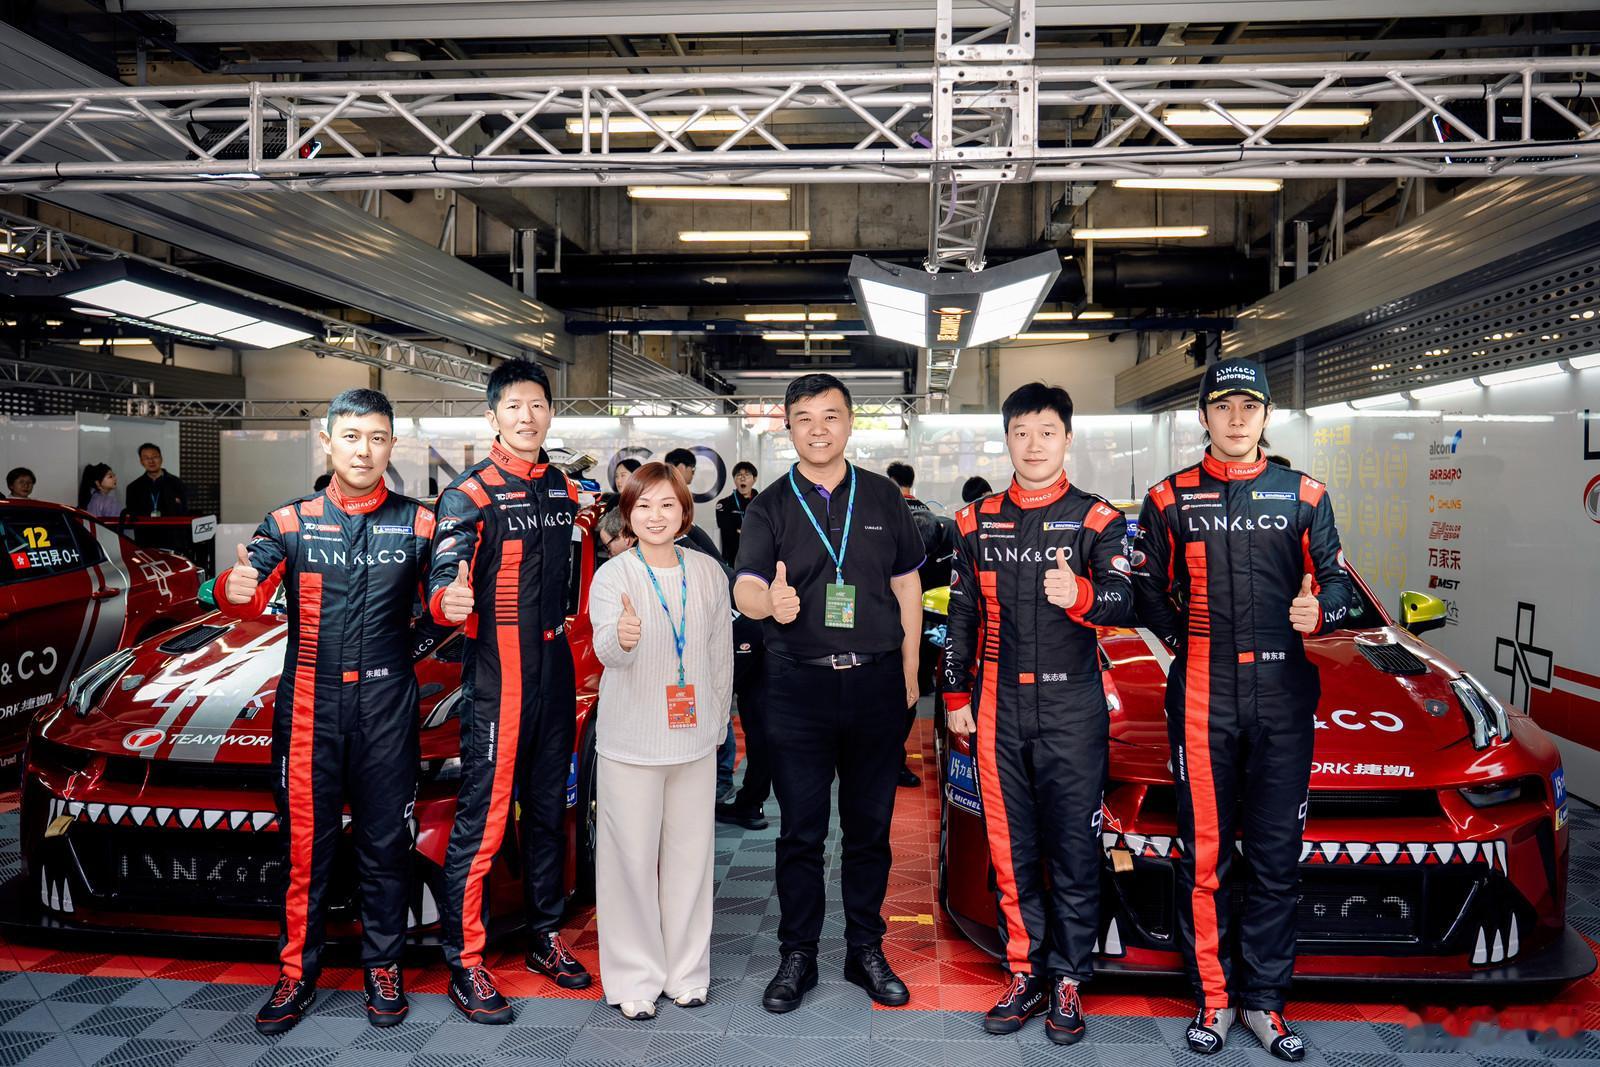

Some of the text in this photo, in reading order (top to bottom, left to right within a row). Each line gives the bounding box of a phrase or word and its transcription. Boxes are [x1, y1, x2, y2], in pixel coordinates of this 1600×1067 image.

[1429, 440, 1450, 455] alcon
[508, 511, 572, 531] LYNK&CO
[1189, 514, 1288, 532] LYNK&CO
[24, 527, 51, 548] 12
[27, 549, 62, 567] 王日昇
[307, 548, 407, 565] LYNK&CO
[984, 546, 1073, 562] LYNK&CO
[1428, 548, 1461, 570] 万家乐
